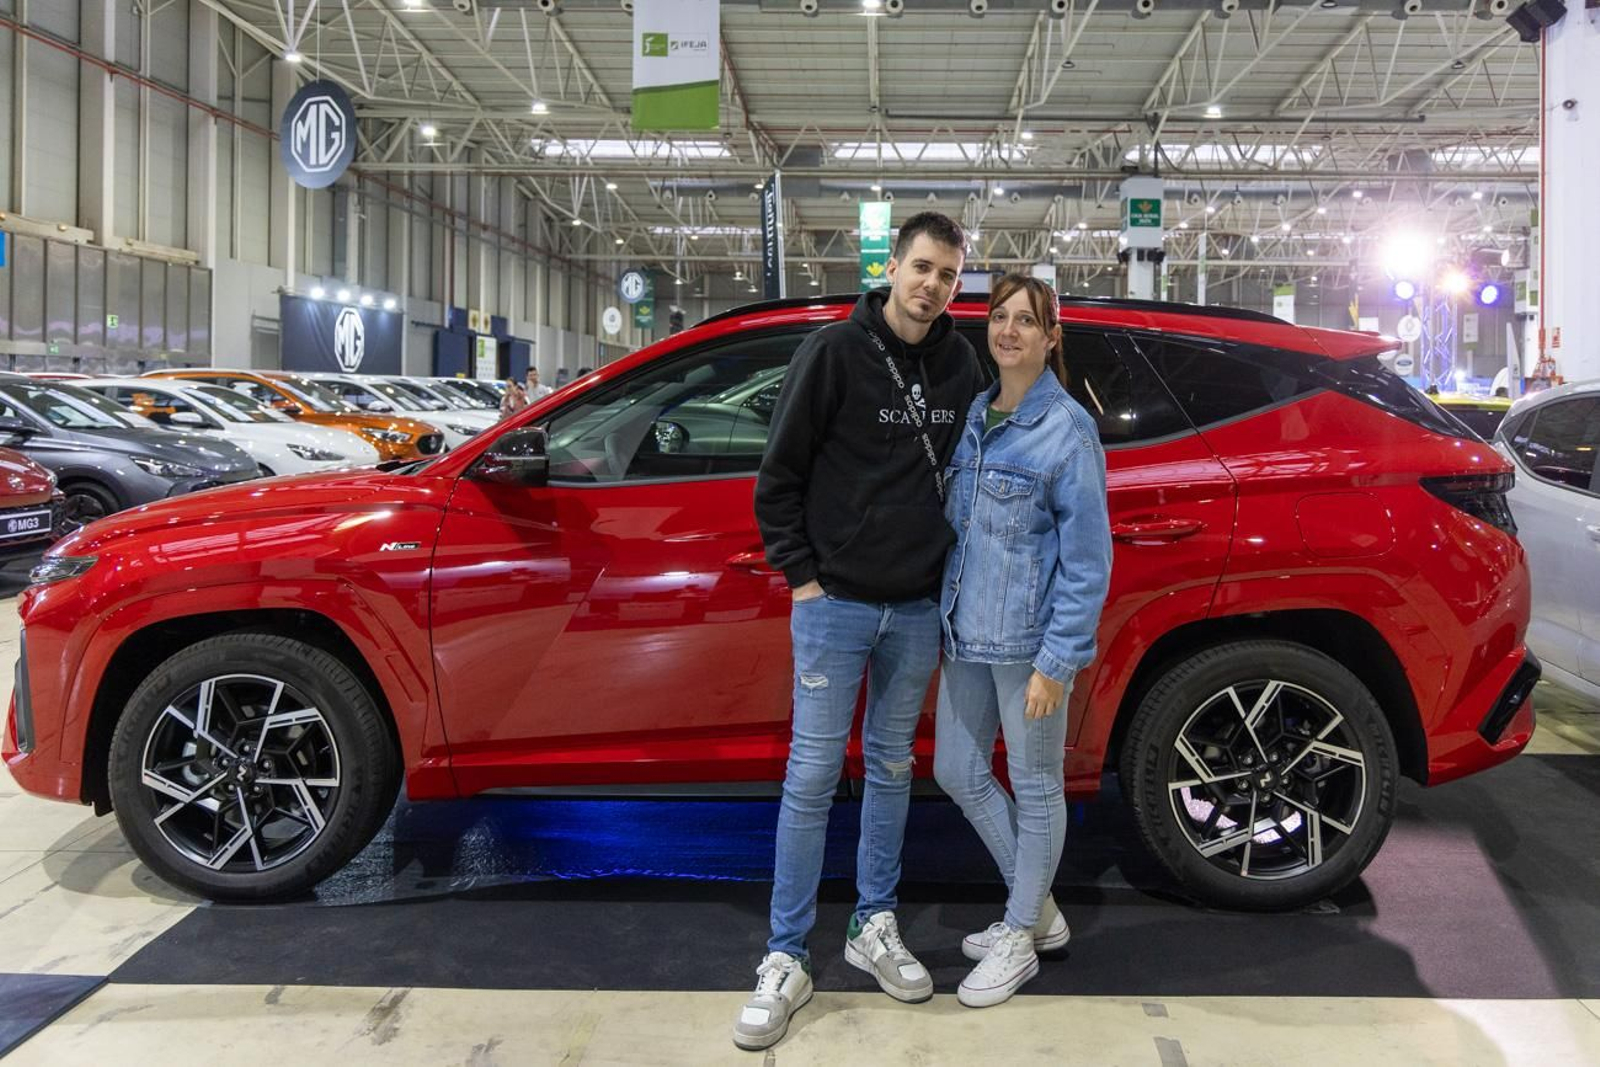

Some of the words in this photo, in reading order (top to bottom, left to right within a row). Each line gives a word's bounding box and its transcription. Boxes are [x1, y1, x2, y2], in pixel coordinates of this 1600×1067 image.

[680, 40, 708, 49] IFEJA
[294, 101, 342, 168] MG
[336, 310, 363, 369] MG
[885, 356, 905, 389] adidas
[878, 408, 956, 424] SCAERS
[904, 394, 923, 428] adidas
[922, 433, 937, 466] adidas
[17, 517, 39, 531] MG3
